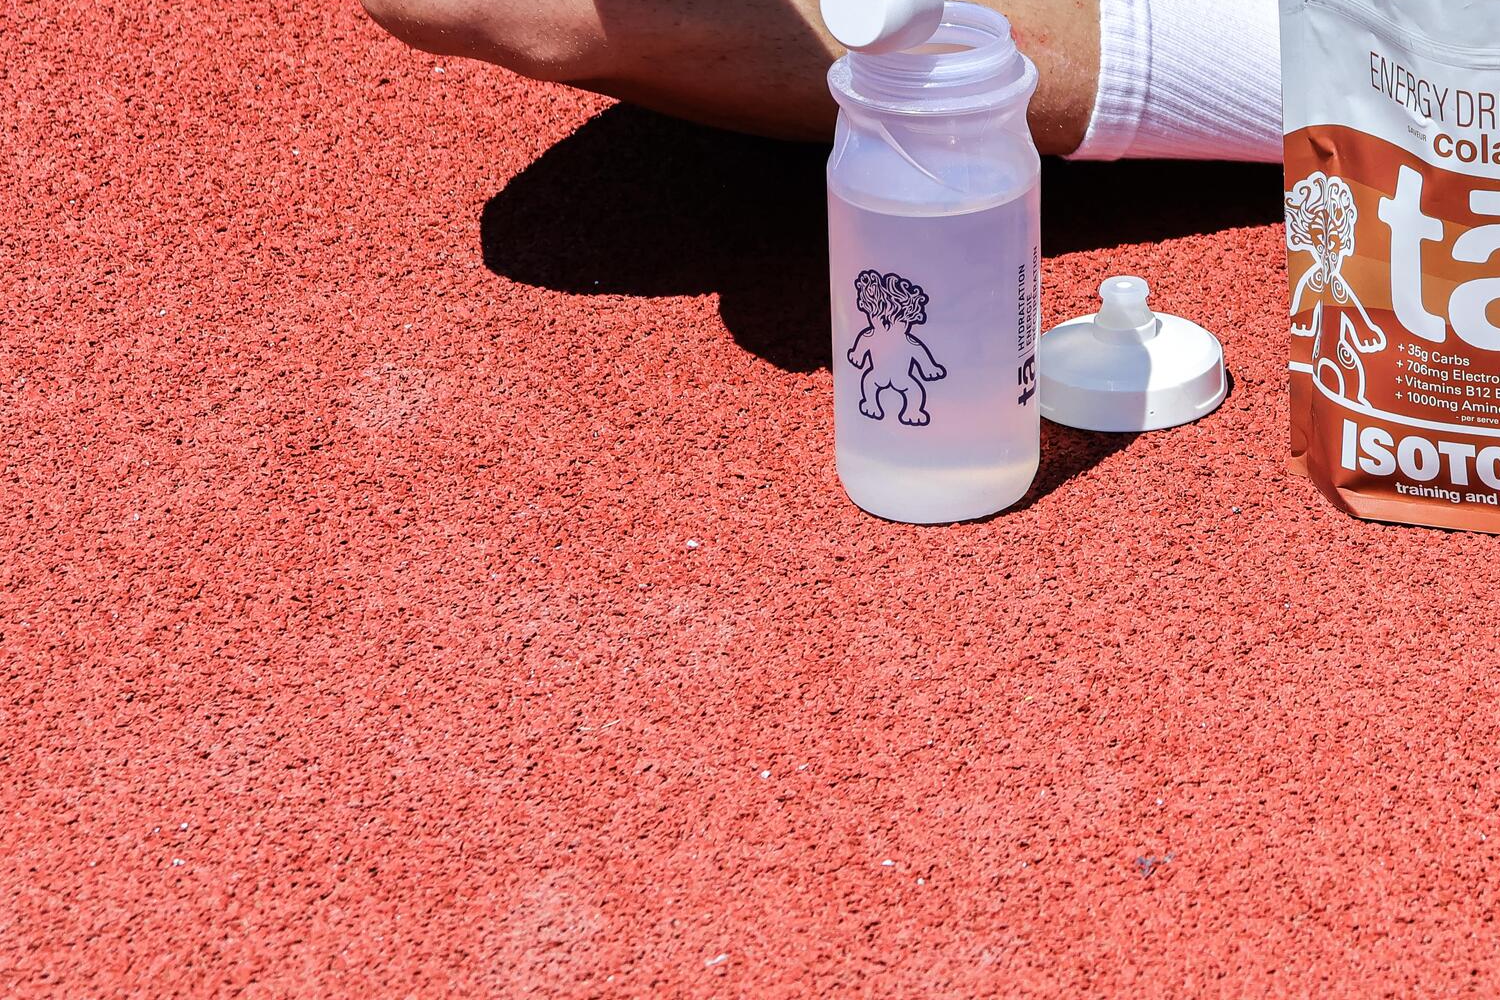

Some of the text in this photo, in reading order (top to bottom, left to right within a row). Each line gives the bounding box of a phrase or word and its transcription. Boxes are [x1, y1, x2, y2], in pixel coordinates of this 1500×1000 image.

[1370, 51, 1449, 122] ENERGY
[1407, 124, 1427, 142] SAVEUR
[1017, 263, 1026, 352] HYDRATATION
[1407, 343, 1429, 363] 35g
[1431, 351, 1471, 367] Carbs
[1407, 359, 1449, 381] 706mg
[1405, 375, 1462, 396] Vitamins
[1465, 386, 1491, 399] B12
[1406, 391, 1458, 412] 1000mg
[1461, 415, 1475, 423] per
[1476, 416, 1499, 425] serve
[1395, 482, 1461, 503] training
[1465, 492, 1498, 506] and
